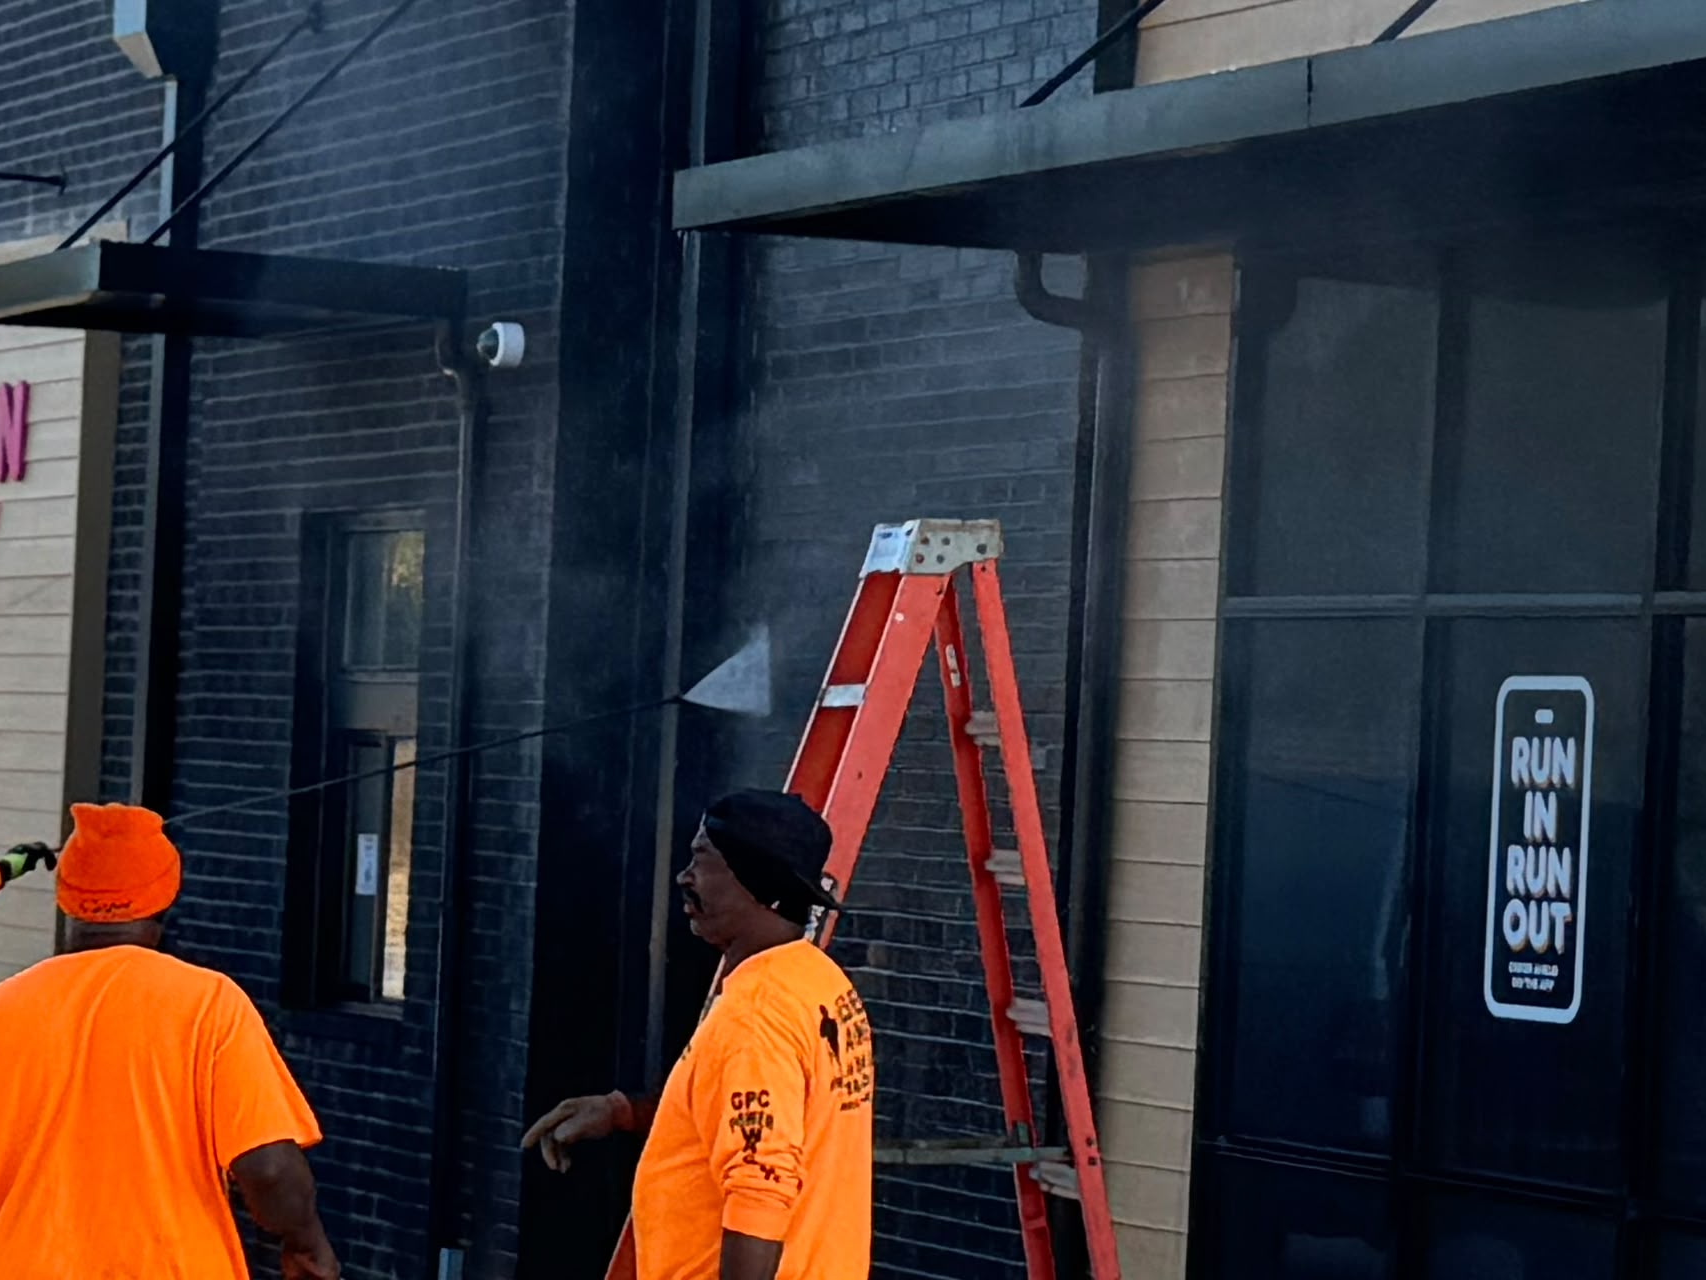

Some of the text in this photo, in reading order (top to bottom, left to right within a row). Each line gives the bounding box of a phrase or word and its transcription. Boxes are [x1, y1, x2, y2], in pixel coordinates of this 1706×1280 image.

[1511, 736, 1577, 788] RUN
[1523, 790, 1558, 842] IN
[1506, 844, 1572, 900] RUN
[1503, 898, 1573, 954] OUT
[730, 1089, 771, 1111] GPC
